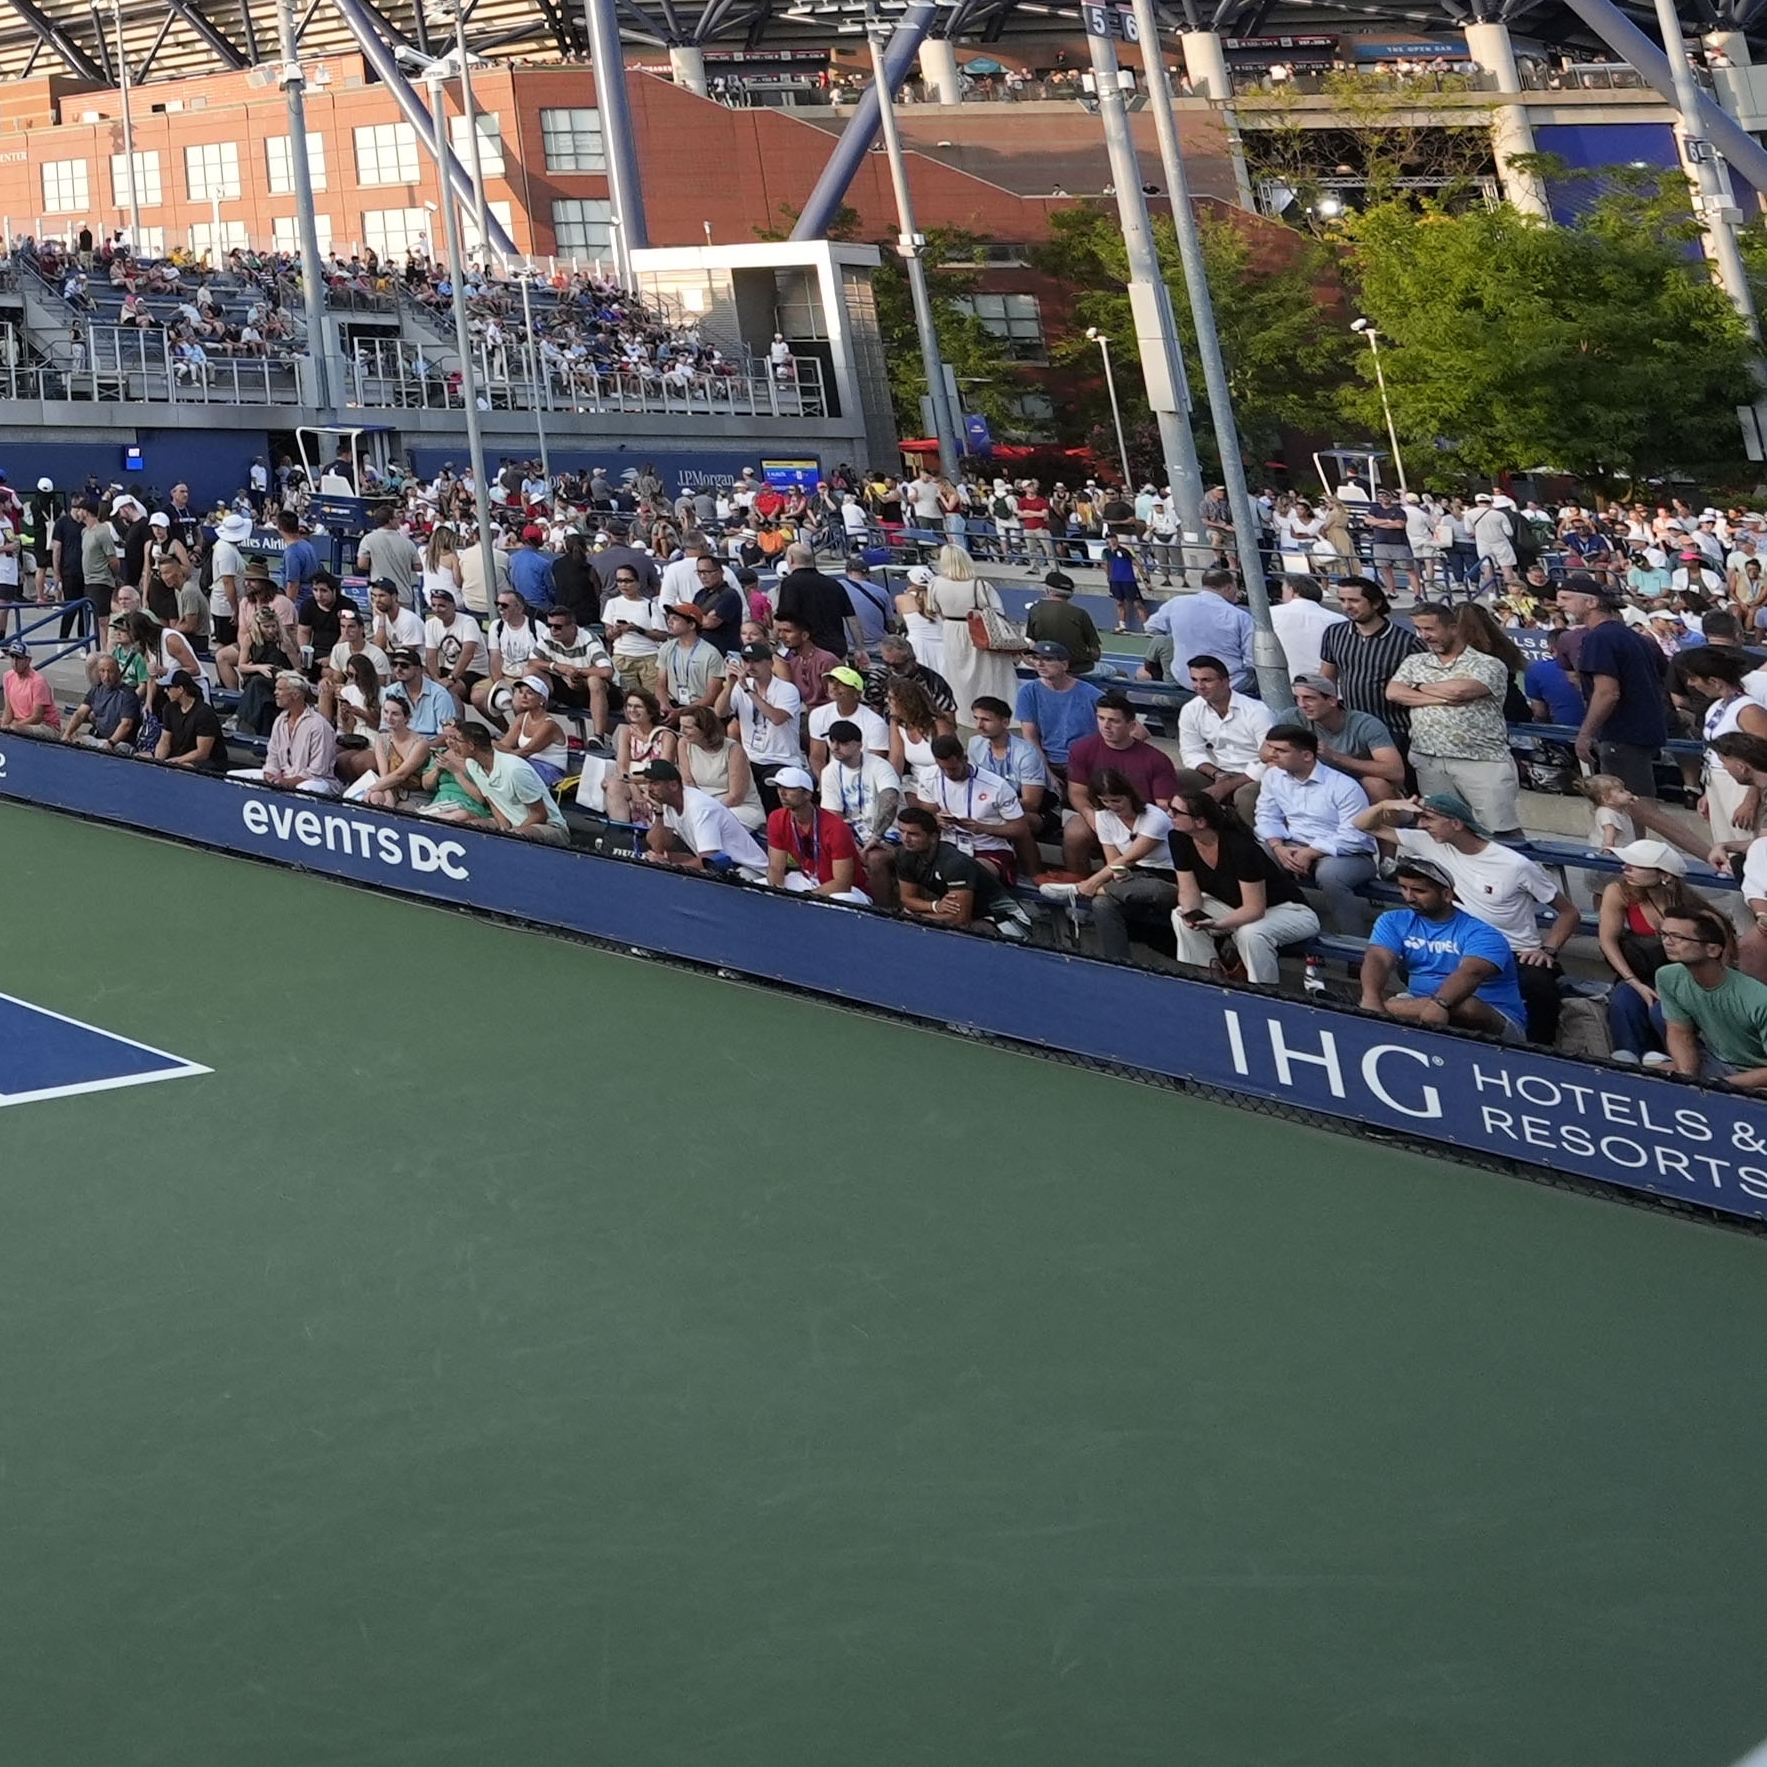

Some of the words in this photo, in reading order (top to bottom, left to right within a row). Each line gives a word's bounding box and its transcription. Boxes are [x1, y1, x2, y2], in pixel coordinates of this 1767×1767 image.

[1092, 8, 1106, 34] 5
[1126, 15, 1139, 41] 6
[1689, 142, 1698, 162] 6
[262, 538, 288, 551] Airli
[408, 833, 469, 881] DC
[1224, 1009, 1444, 1119] IHG
[1472, 1063, 1713, 1142] HOTELS
[1732, 1121, 1767, 1156] &
[1481, 1105, 1767, 1200] RESORTS
